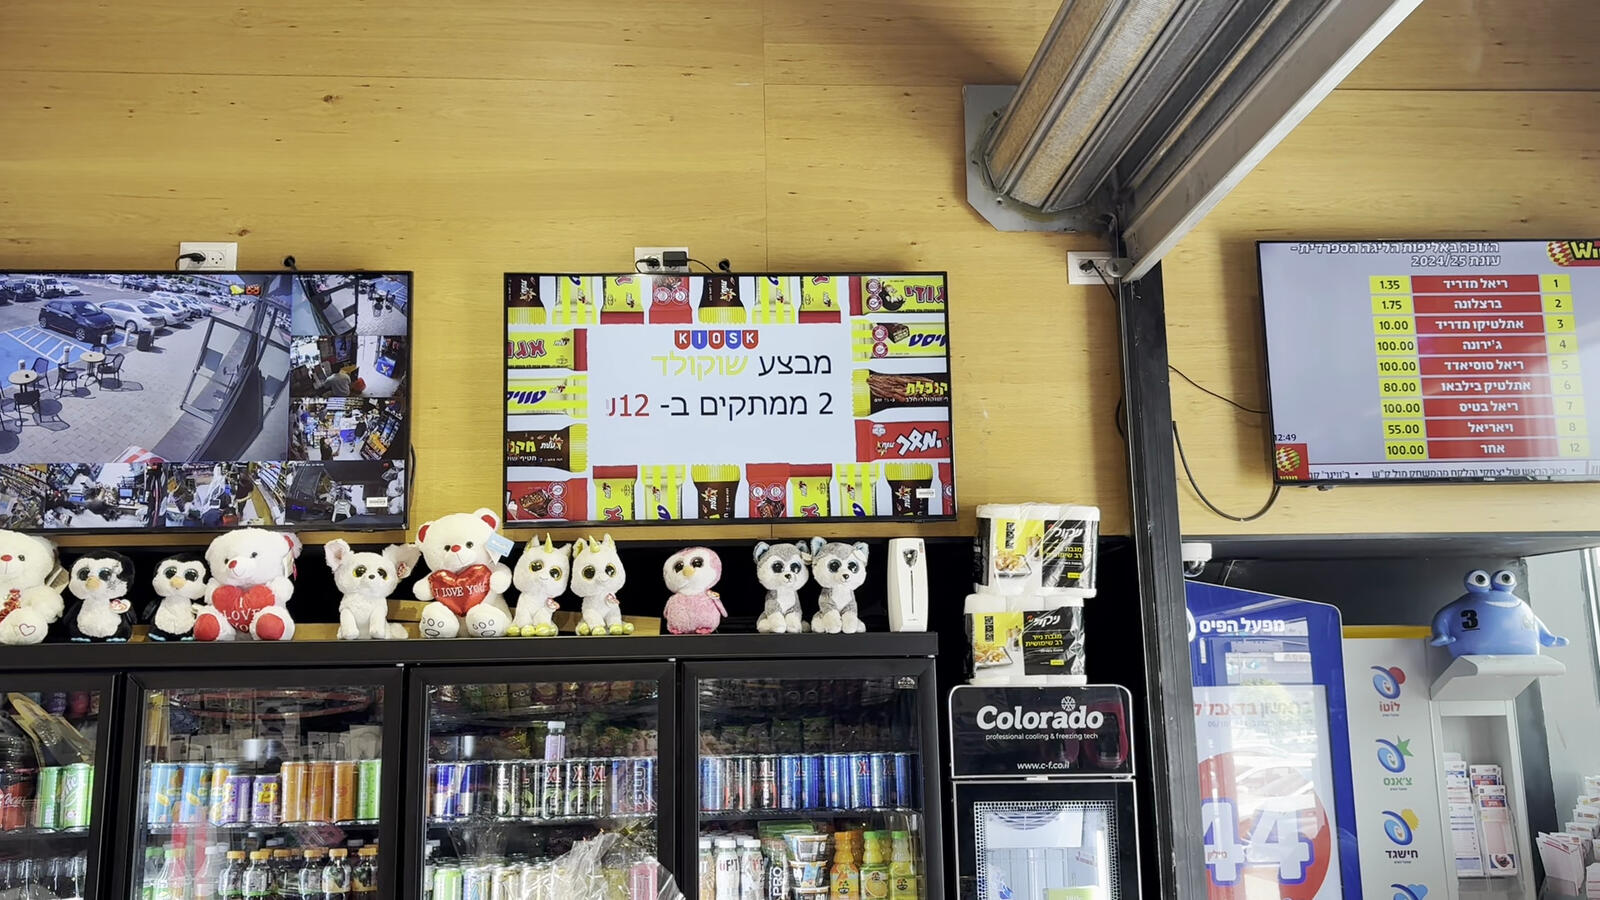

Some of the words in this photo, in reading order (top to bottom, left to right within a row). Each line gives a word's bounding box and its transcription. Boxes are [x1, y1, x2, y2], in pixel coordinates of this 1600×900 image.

[1361, 242, 1400, 253] הליגה
[1402, 242, 1458, 254] באליפות
[1460, 242, 1500, 253] הזוכה
[1411, 256, 1466, 268] 2024/25
[1469, 256, 1500, 266] עונת
[1380, 280, 1400, 290] 1.35
[1443, 280, 1478, 289] מדריד
[1481, 278, 1508, 288] ריאל
[1554, 279, 1558, 288] 1
[1382, 300, 1402, 310] 1.75
[1454, 299, 1502, 310] ברצלונה
[1555, 300, 1562, 308] 2
[1379, 320, 1408, 330] 10.00
[1435, 320, 1470, 330] מדריד
[1472, 320, 1524, 332] אתלטיקו
[1557, 319, 1564, 328] 3
[677, 331, 757, 346] KIOSK
[1378, 341, 1414, 351] 100.00
[1462, 340, 1502, 350] ג'ירונה
[1559, 340, 1566, 349] 4
[651, 350, 749, 381] שוקולד
[758, 354, 832, 376] מבצע
[1379, 361, 1416, 371] 100.00
[1444, 360, 1494, 370] סוסיאדד
[1496, 360, 1524, 370] ריאל
[1562, 360, 1568, 370] 5
[1384, 383, 1416, 392] 80.00
[1440, 382, 1481, 392] בילבאו
[1484, 381, 1530, 394] אתלטיק
[1564, 381, 1572, 390] 6
[818, 392, 834, 415] 2
[1459, 403, 1489, 412] בטיס
[1490, 402, 1518, 412] ריאל
[1567, 402, 1574, 410] 7
[700, 396, 808, 422] ממתקים
[1384, 404, 1420, 414] 100.00
[1388, 425, 1420, 434] 55.00
[1467, 422, 1514, 434] ויאריאל
[1569, 422, 1576, 432] 8
[1387, 446, 1424, 456] 100.00
[1480, 444, 1505, 454] אחר
[440, 586, 464, 597] LOVE
[238, 596, 243, 608] I
[223, 608, 260, 620] LOVE
[1461, 608, 1478, 630] 3
[231, 622, 249, 632] YO
[1200, 619, 1238, 634] הפיס
[1242, 616, 1286, 632] מפעל
[976, 704, 1104, 730] Colorado
[986, 732, 1024, 741] professional
[1025, 732, 1050, 741] cooling
[1056, 732, 1082, 742] freezing
[1084, 732, 1098, 740] tech
[1016, 760, 1070, 770] www.c-f.co.il
[1385, 850, 1418, 859] חישגד
